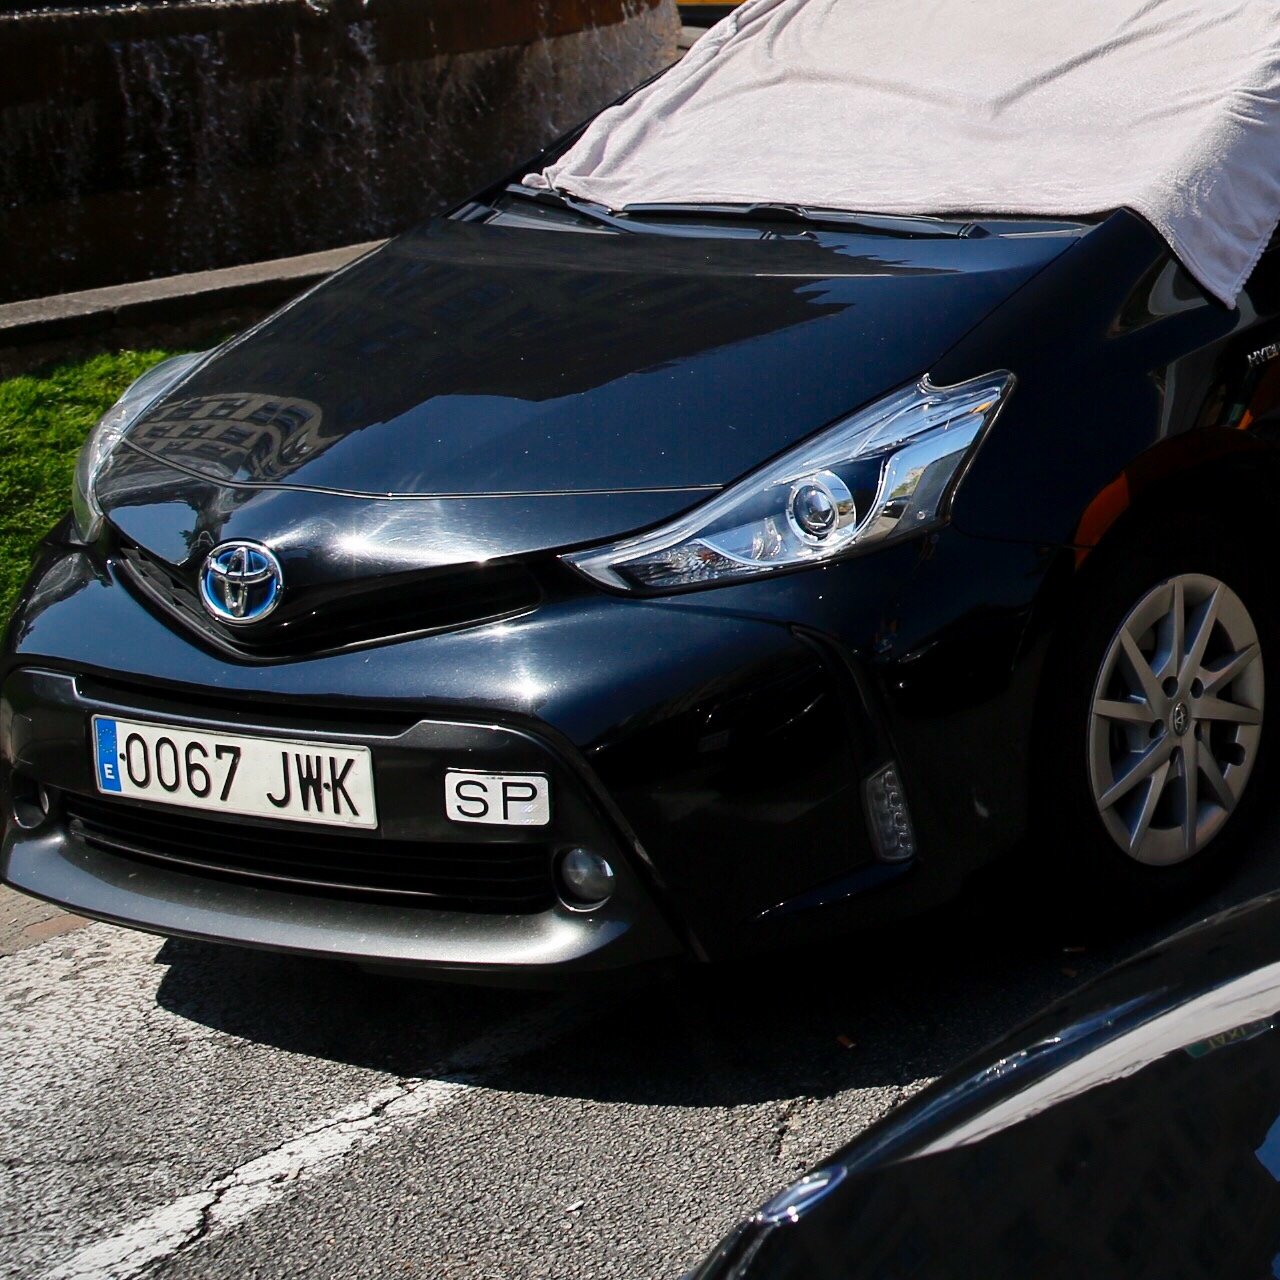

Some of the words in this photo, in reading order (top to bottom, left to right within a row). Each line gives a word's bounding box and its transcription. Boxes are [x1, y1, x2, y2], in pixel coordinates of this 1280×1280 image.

[104, 763, 115, 780] E
[125, 732, 241, 801] 0067
[267, 751, 359, 816] JWK
[456, 780, 538, 820] SP
